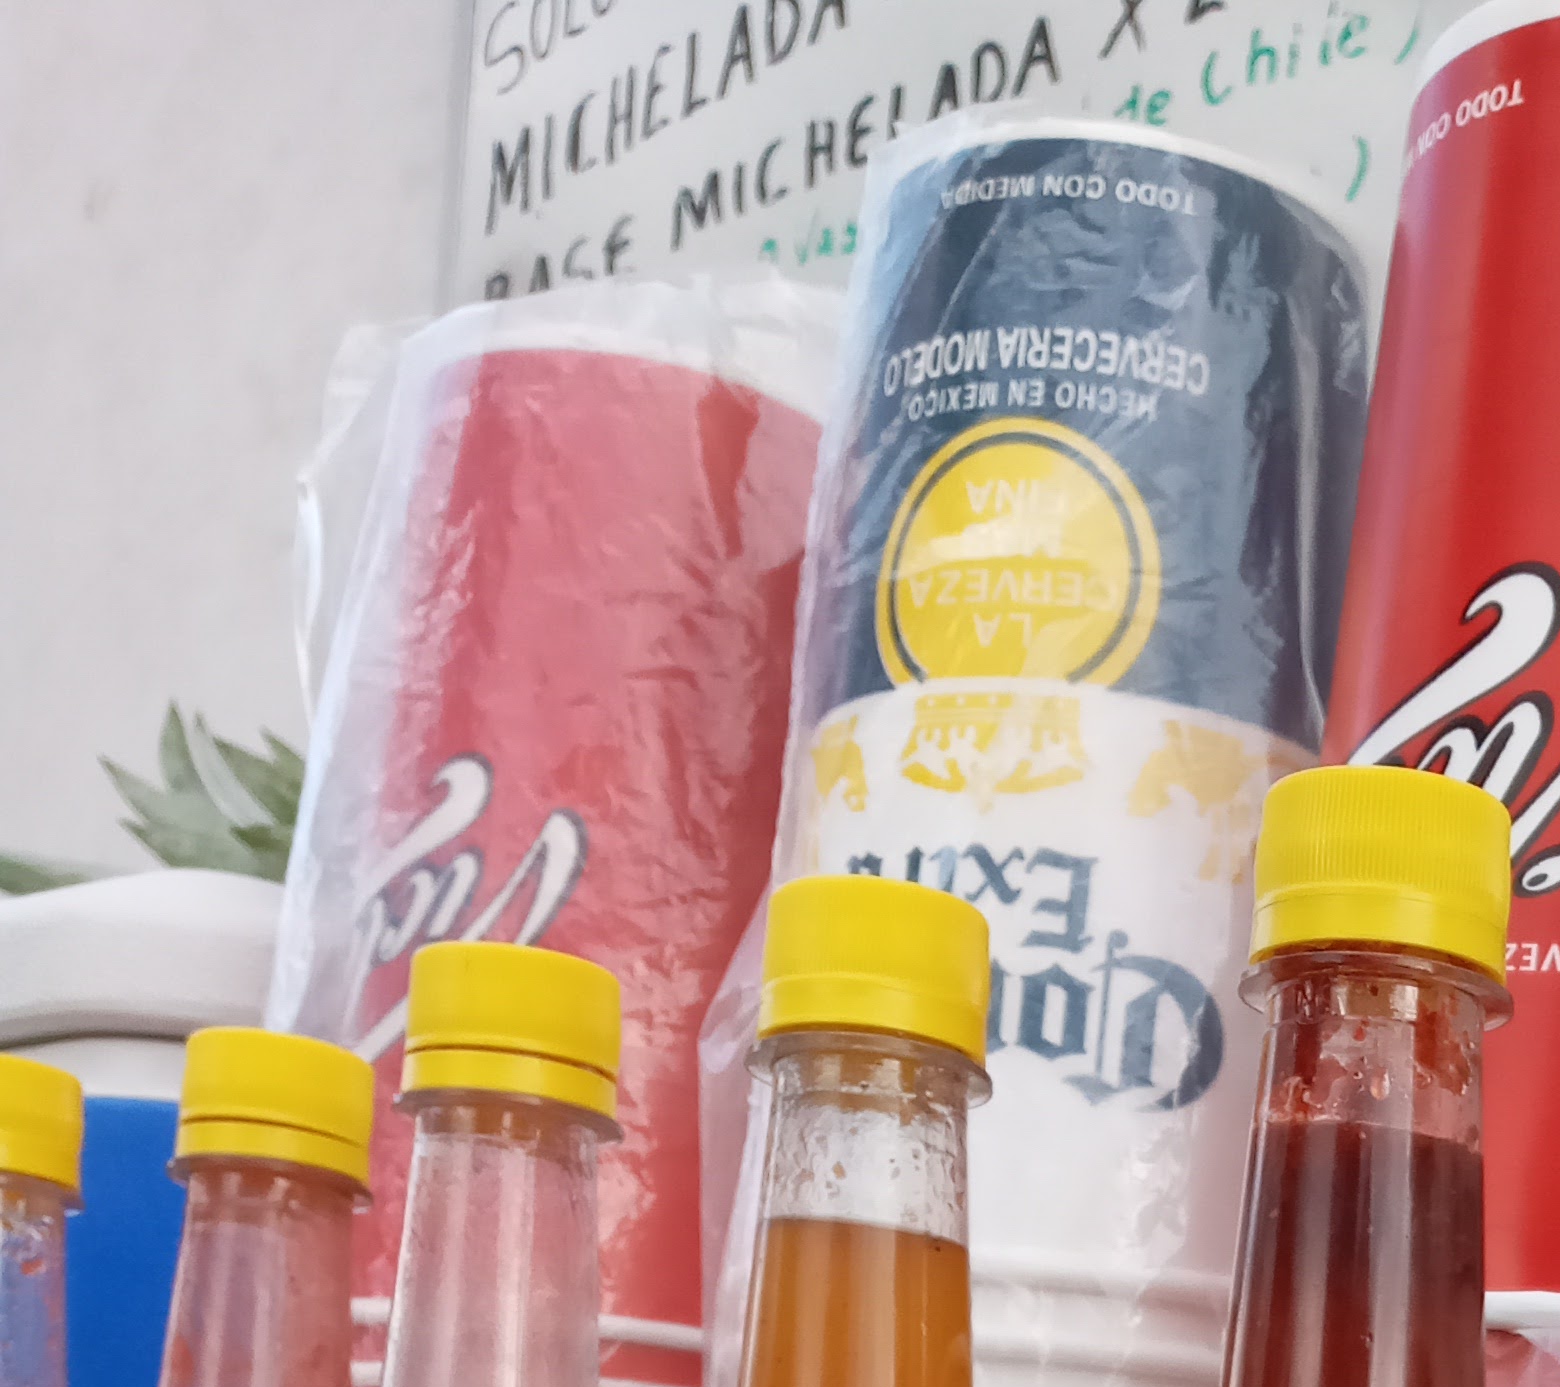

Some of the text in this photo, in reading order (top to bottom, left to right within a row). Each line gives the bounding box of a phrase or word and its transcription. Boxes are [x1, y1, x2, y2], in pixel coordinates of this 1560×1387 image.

[485, 0, 616, 96] SOL
[485, 0, 846, 236] MICHELADA
[1455, 78, 1525, 127] TODO
[1416, 110, 1452, 157] CON
[1042, 174, 1107, 201] CON
[1114, 176, 1199, 216] TODO
[882, 327, 991, 397] MODELO
[1006, 379, 1044, 406] EN
[1054, 383, 1158, 422] HECHO
[972, 611, 1033, 648] LA
